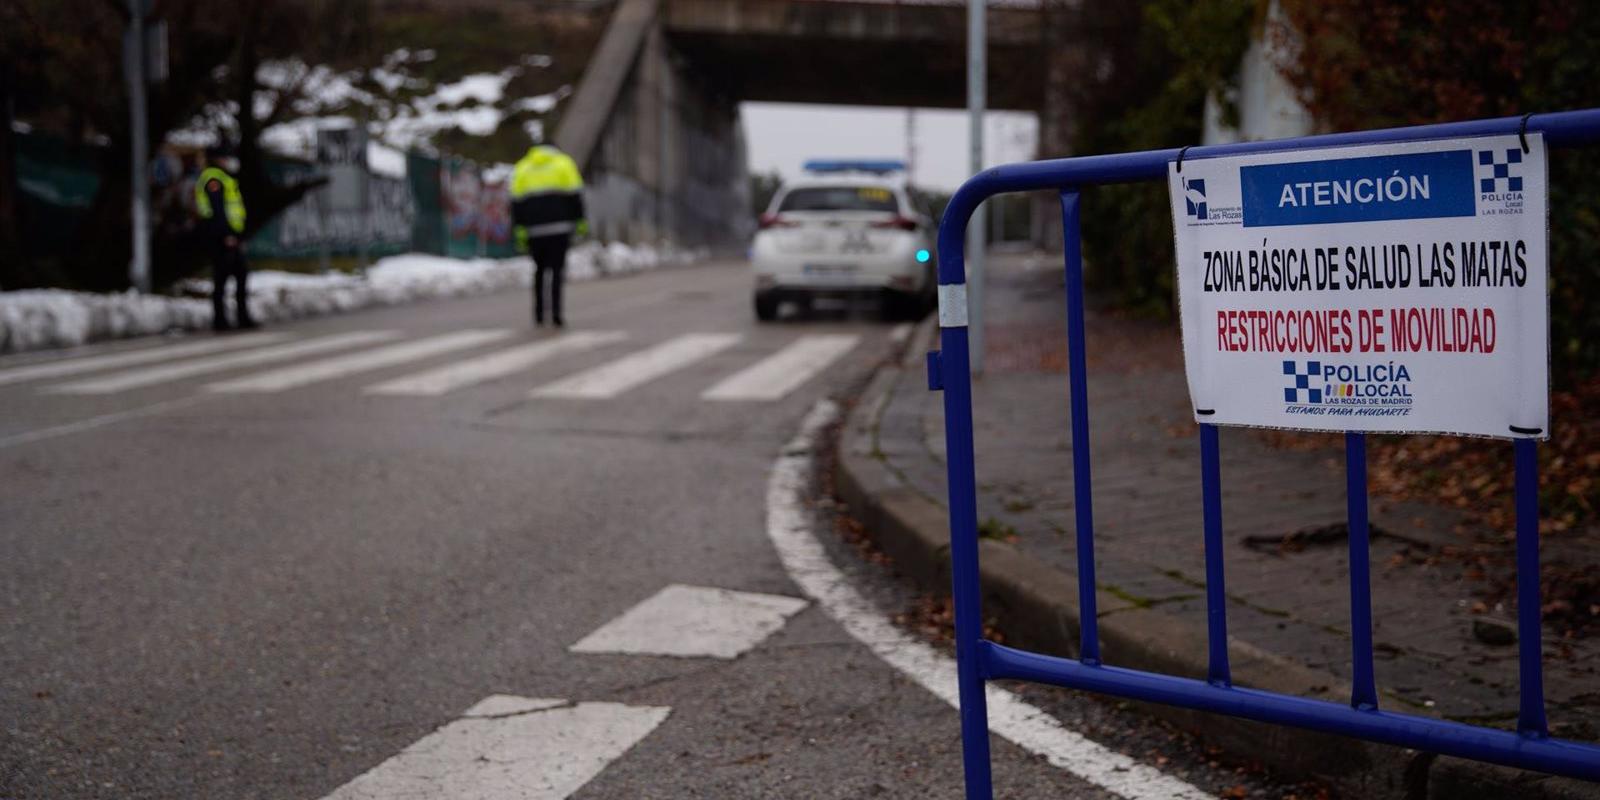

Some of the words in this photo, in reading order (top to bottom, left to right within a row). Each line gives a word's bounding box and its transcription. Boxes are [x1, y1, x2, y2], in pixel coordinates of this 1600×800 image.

[1278, 169, 1430, 208] ATENCIÓN
[1203, 250, 1246, 292] ZONA
[1249, 237, 1312, 292] BÁSICA
[1314, 247, 1341, 291] DE
[1345, 244, 1412, 290] SALUD
[1417, 242, 1456, 288] LAS
[1461, 239, 1527, 288] MATAS
[1217, 309, 1353, 353] RESTRICCIONES
[1358, 309, 1386, 352] DE
[1390, 307, 1496, 353] MOVILIDAD
[1323, 360, 1412, 382] POLICÍA
[1355, 384, 1412, 397] LOCAL
[1285, 405, 1327, 415] ESTAMOS
[1327, 407, 1354, 416] PARA
[1355, 407, 1412, 416] AYUDARTE
